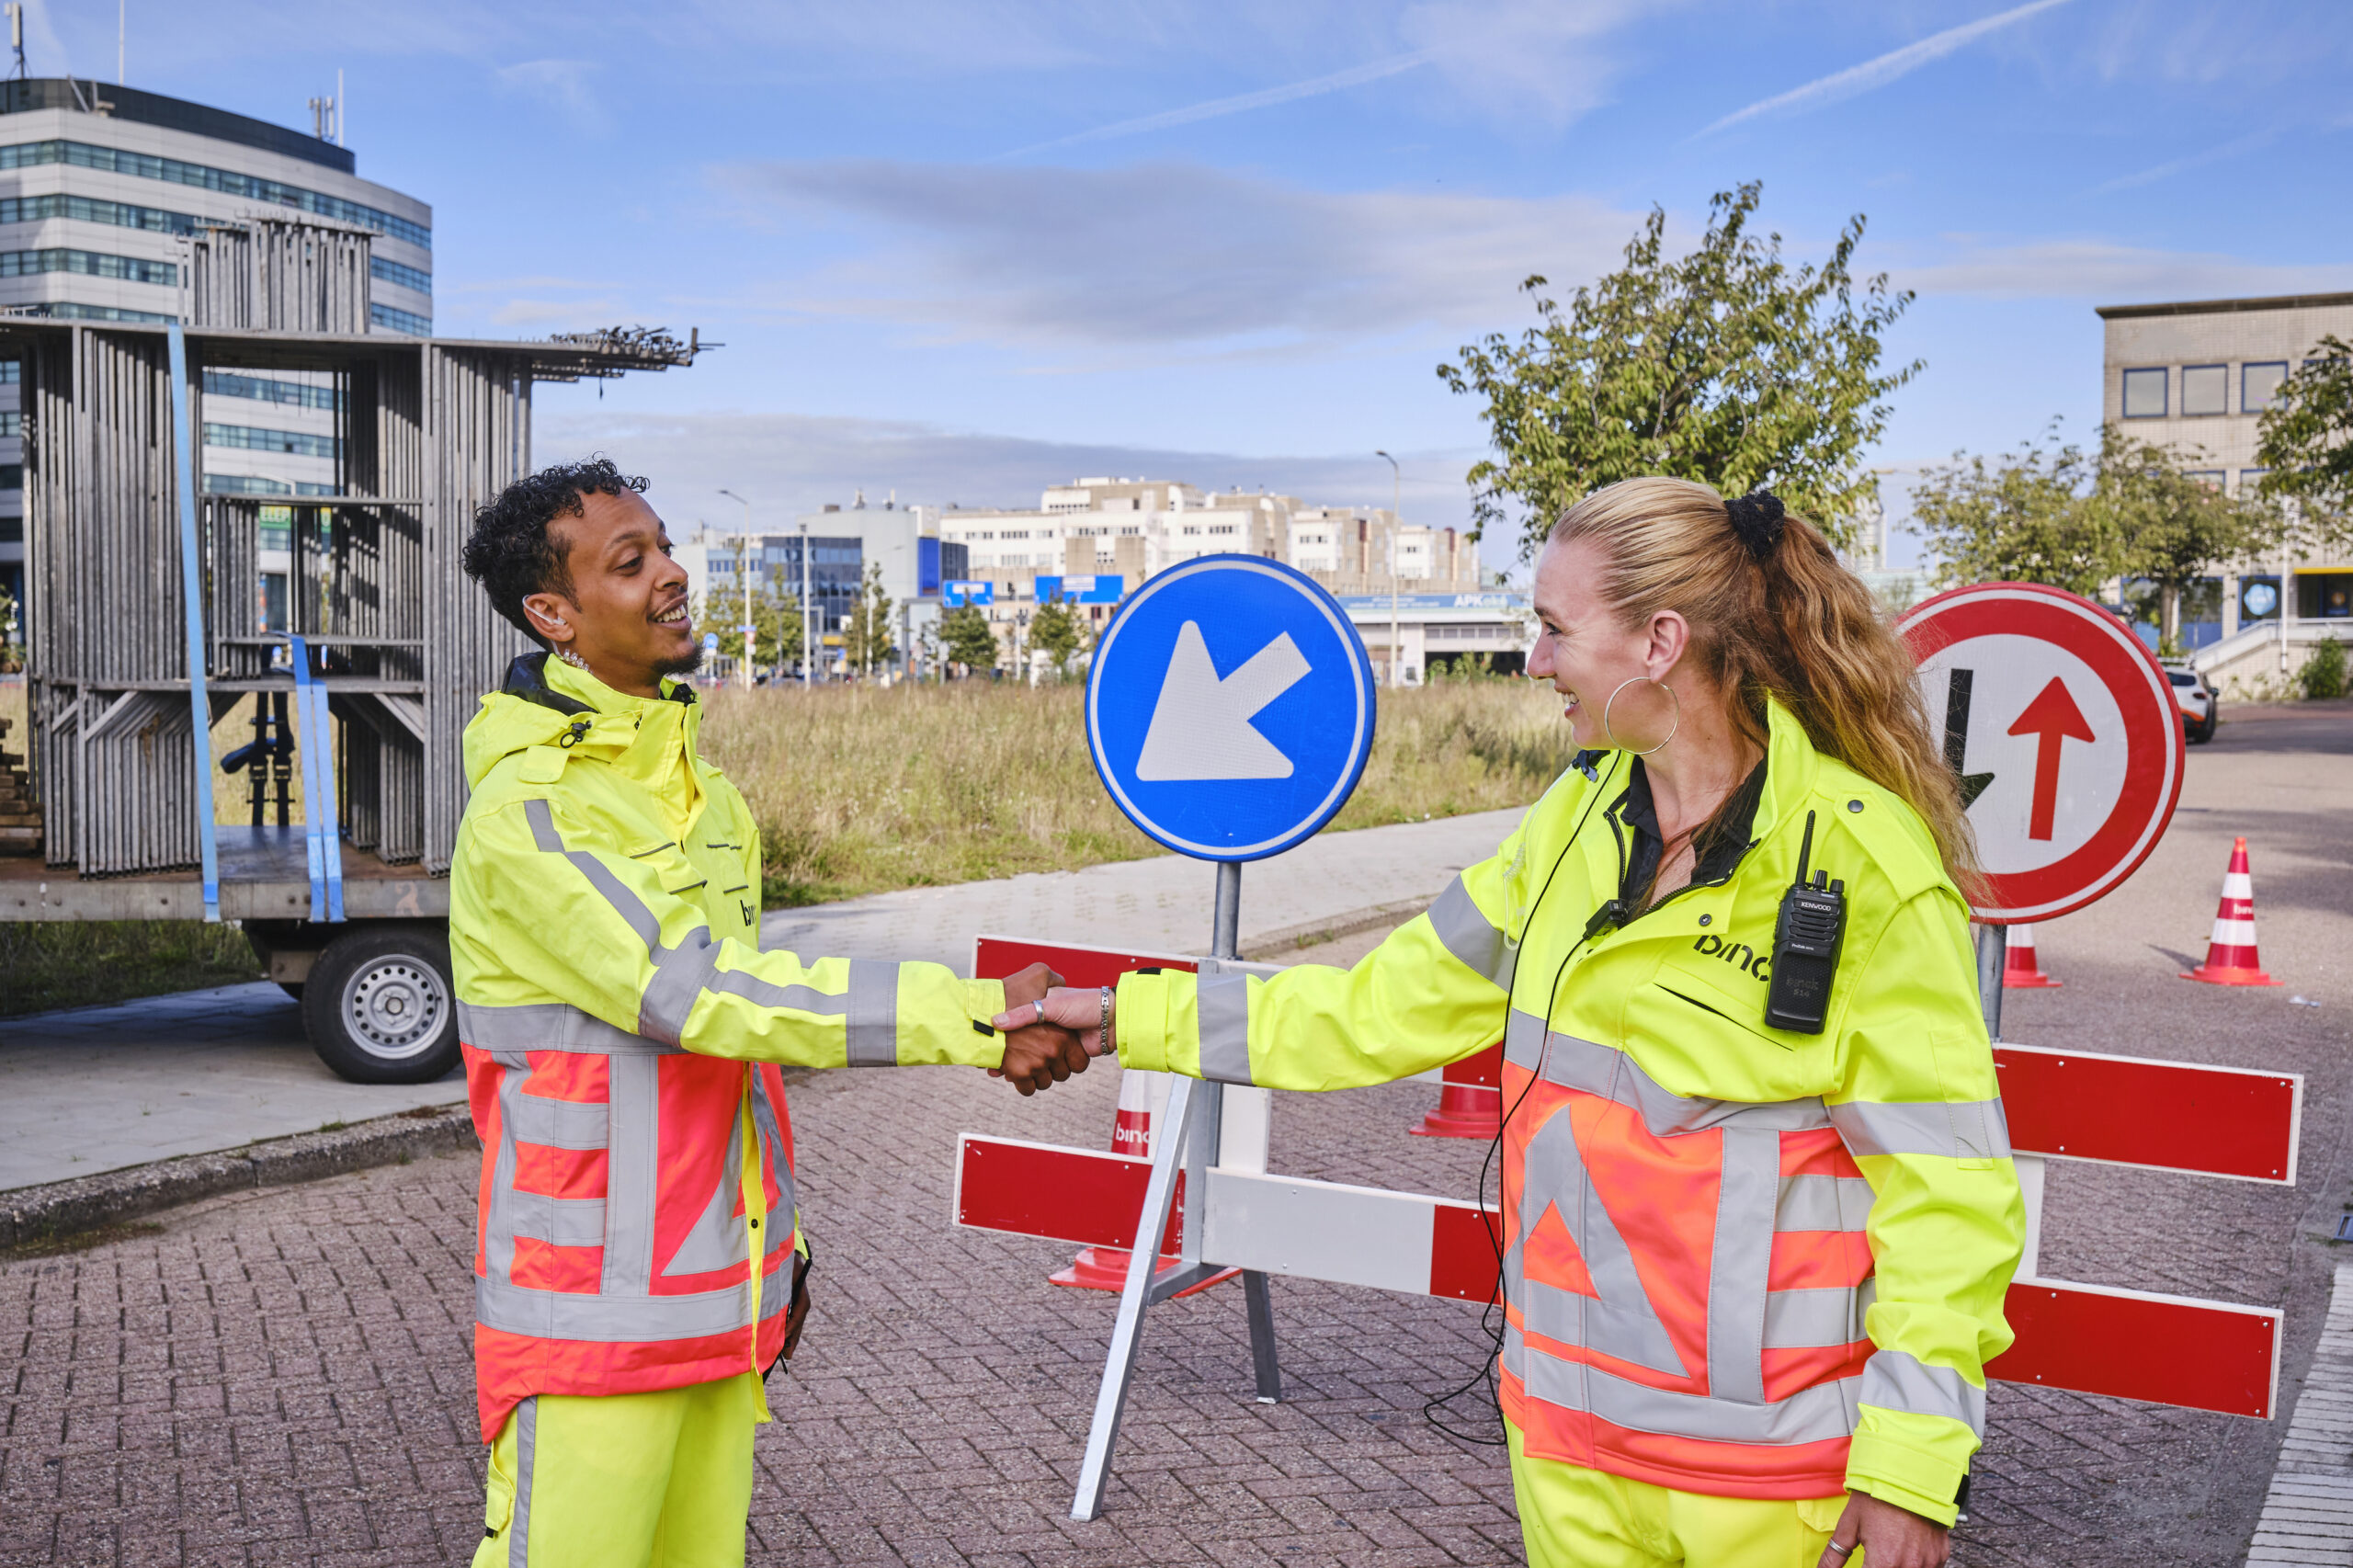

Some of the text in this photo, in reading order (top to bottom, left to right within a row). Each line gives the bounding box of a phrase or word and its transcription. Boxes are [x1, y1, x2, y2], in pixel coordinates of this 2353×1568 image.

[1802, 901, 1832, 912] KENWOOD
[1693, 936, 1772, 982] binc
[1115, 1122, 1149, 1144] binc
